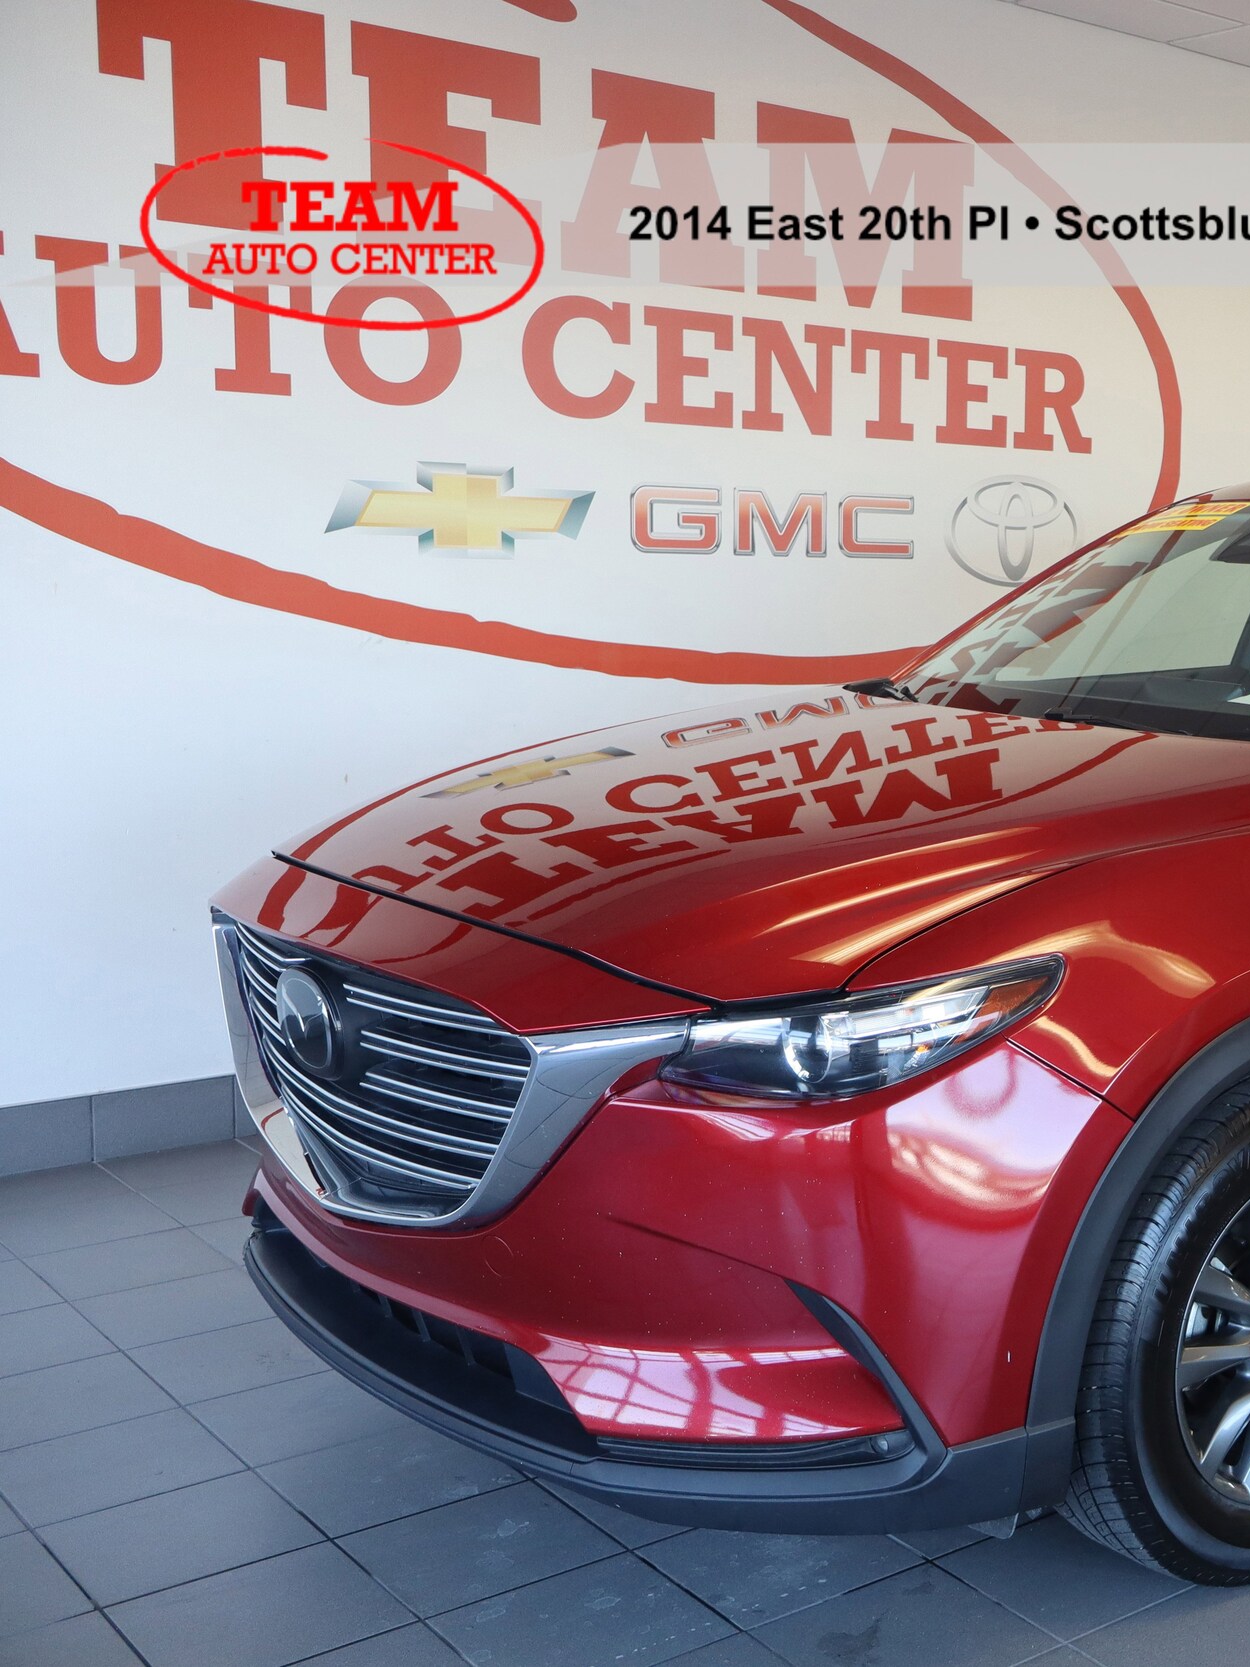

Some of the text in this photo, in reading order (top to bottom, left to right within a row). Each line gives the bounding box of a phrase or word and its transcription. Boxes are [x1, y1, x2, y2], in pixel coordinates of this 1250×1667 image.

[97, 0, 975, 322] TEAM
[0, 231, 1092, 455] UTO CENTER
[629, 484, 915, 559] GMC
